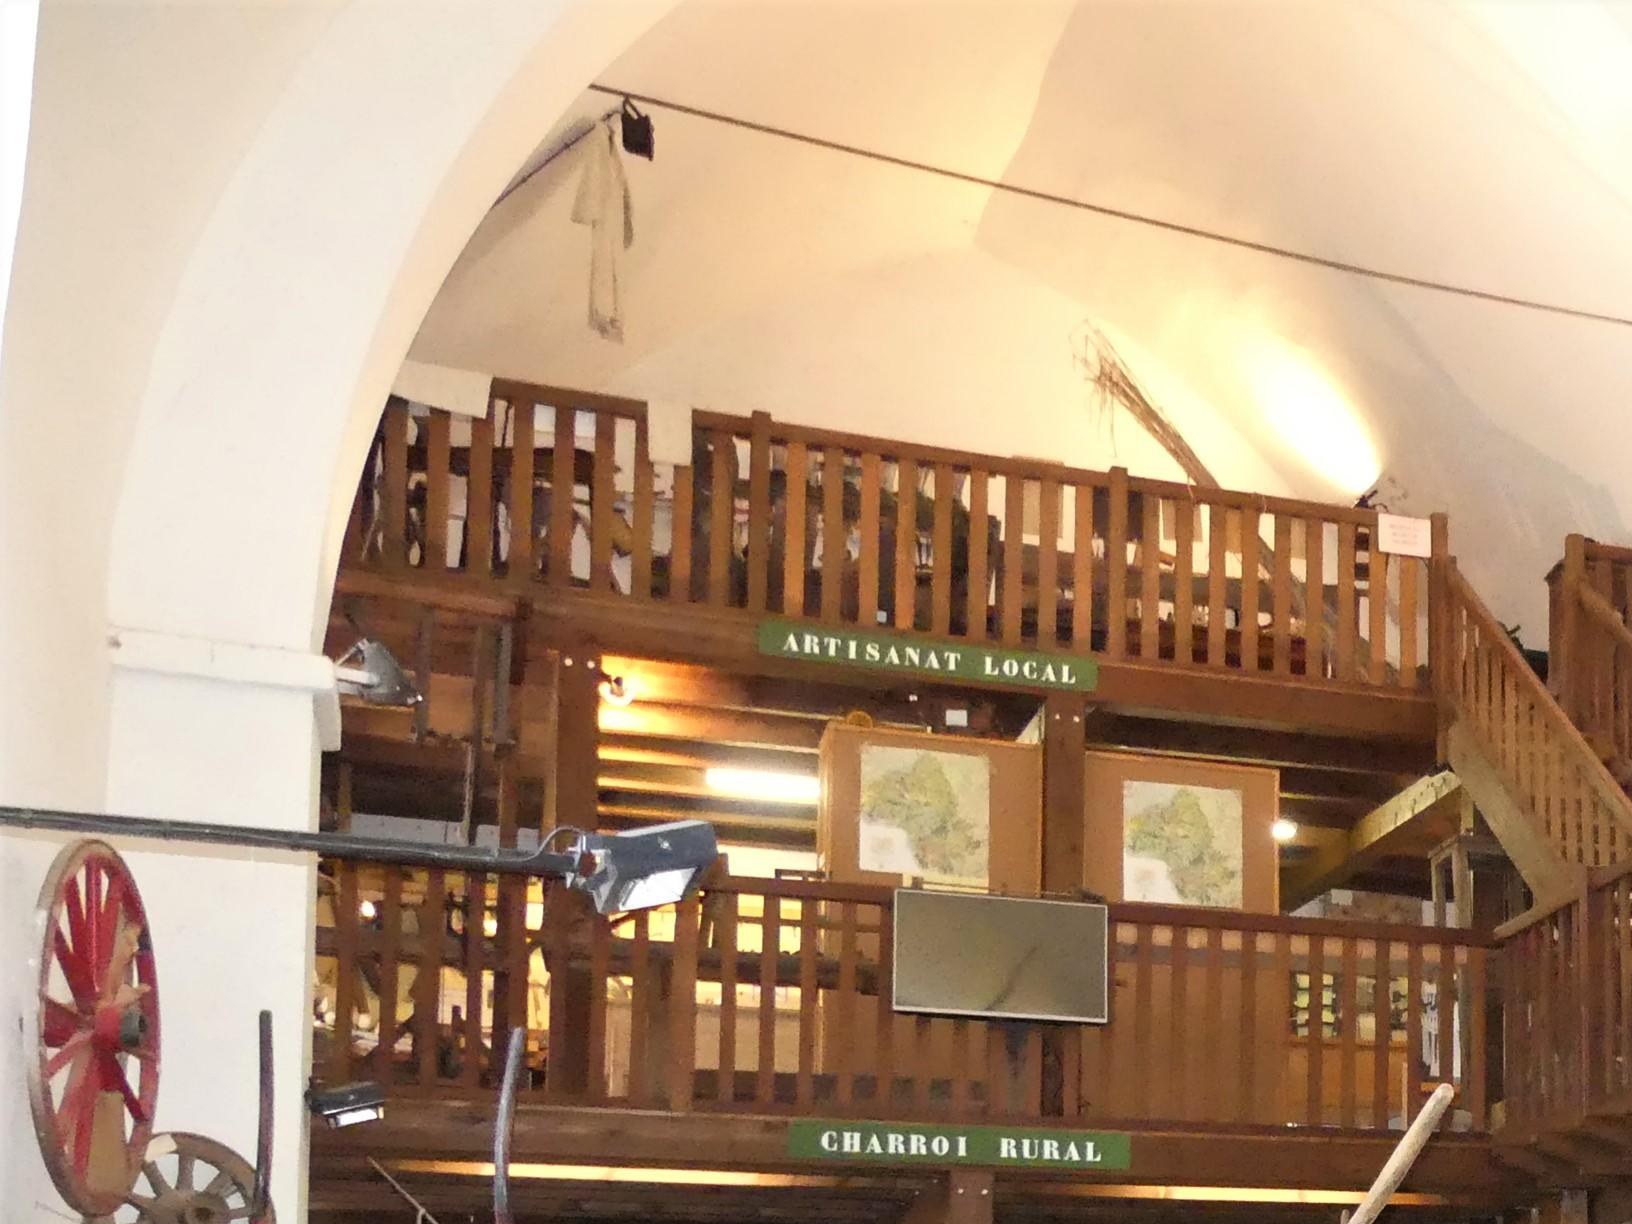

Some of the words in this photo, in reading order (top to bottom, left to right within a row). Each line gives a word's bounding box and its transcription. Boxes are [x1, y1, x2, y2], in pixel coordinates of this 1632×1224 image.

[783, 633, 961, 671] ARTISANAT
[984, 656, 1076, 684] LOCAL
[821, 1130, 967, 1157] CHARROI
[1000, 1137, 1101, 1162] RURAL
